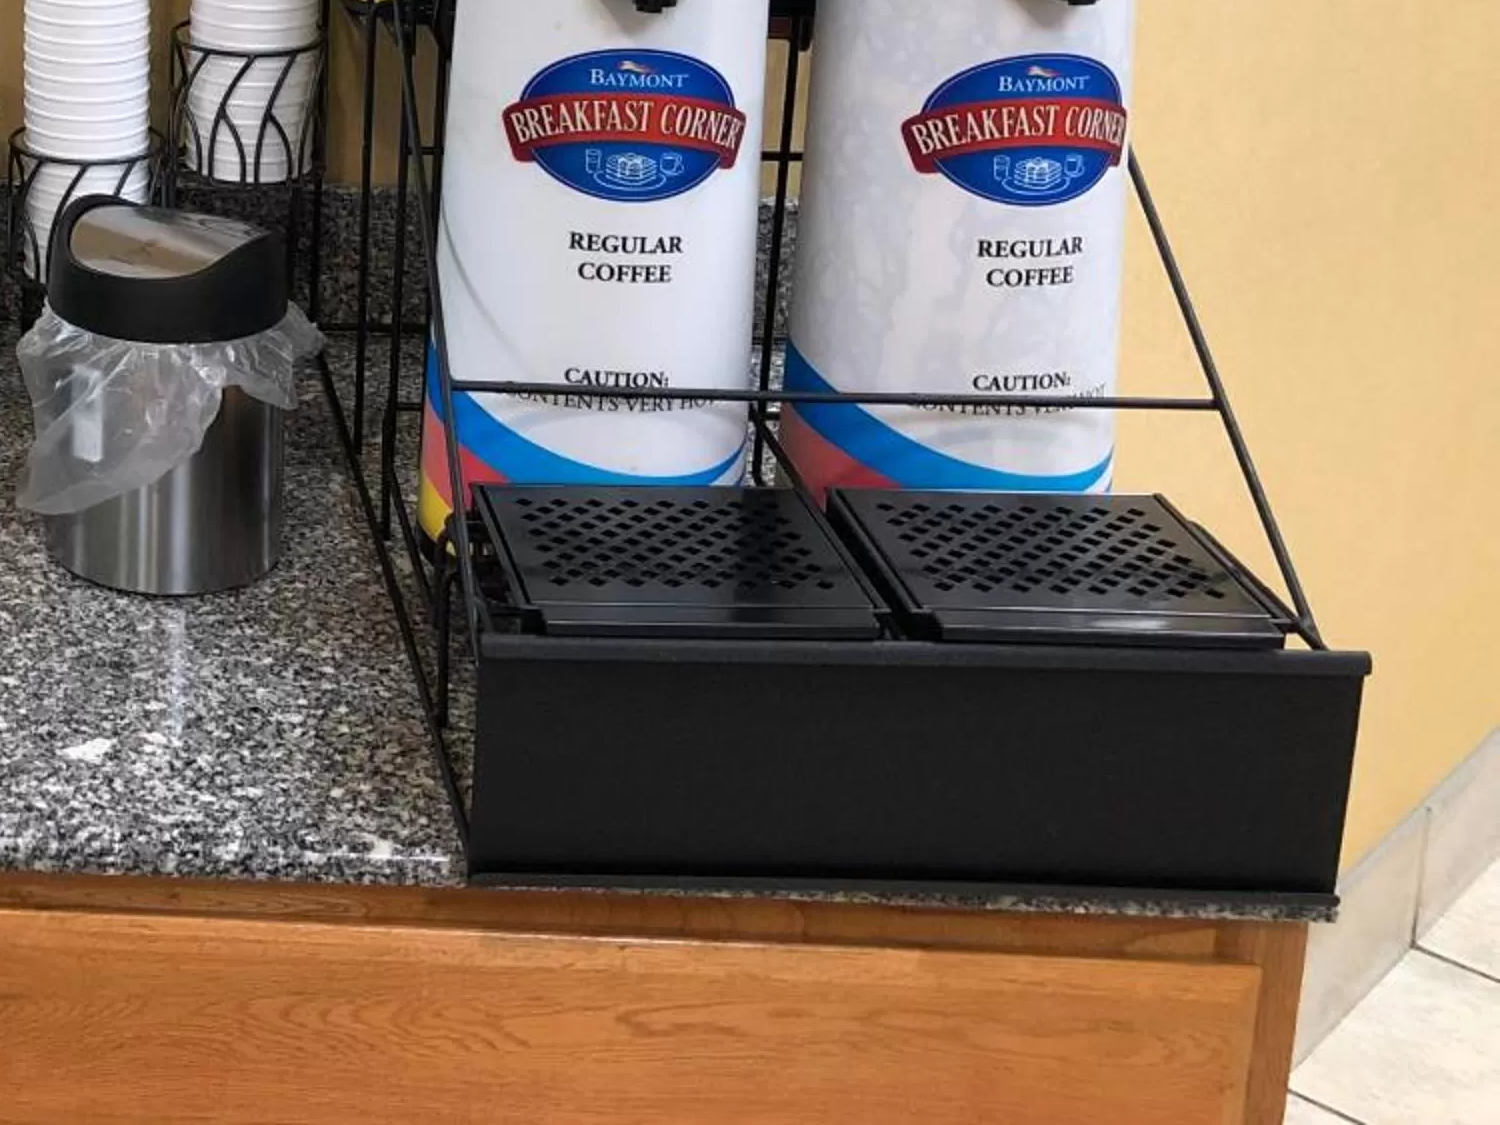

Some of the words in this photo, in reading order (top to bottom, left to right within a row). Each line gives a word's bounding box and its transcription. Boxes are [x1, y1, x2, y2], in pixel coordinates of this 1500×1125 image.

[589, 68, 686, 89] BAYMONT
[998, 75, 1088, 93] BAYMONT
[510, 99, 655, 144] BREAKFAST
[660, 102, 739, 150] CORNER
[911, 104, 1060, 156] BREAKFAST
[1064, 105, 1126, 147] CORNER
[568, 231, 683, 254] REGULAR
[977, 236, 1083, 259] REGULAR
[577, 262, 672, 284] COFFEE
[985, 265, 1075, 288] COFFEE
[564, 367, 669, 388] CAUTION:
[973, 371, 1070, 391] CAUTION:
